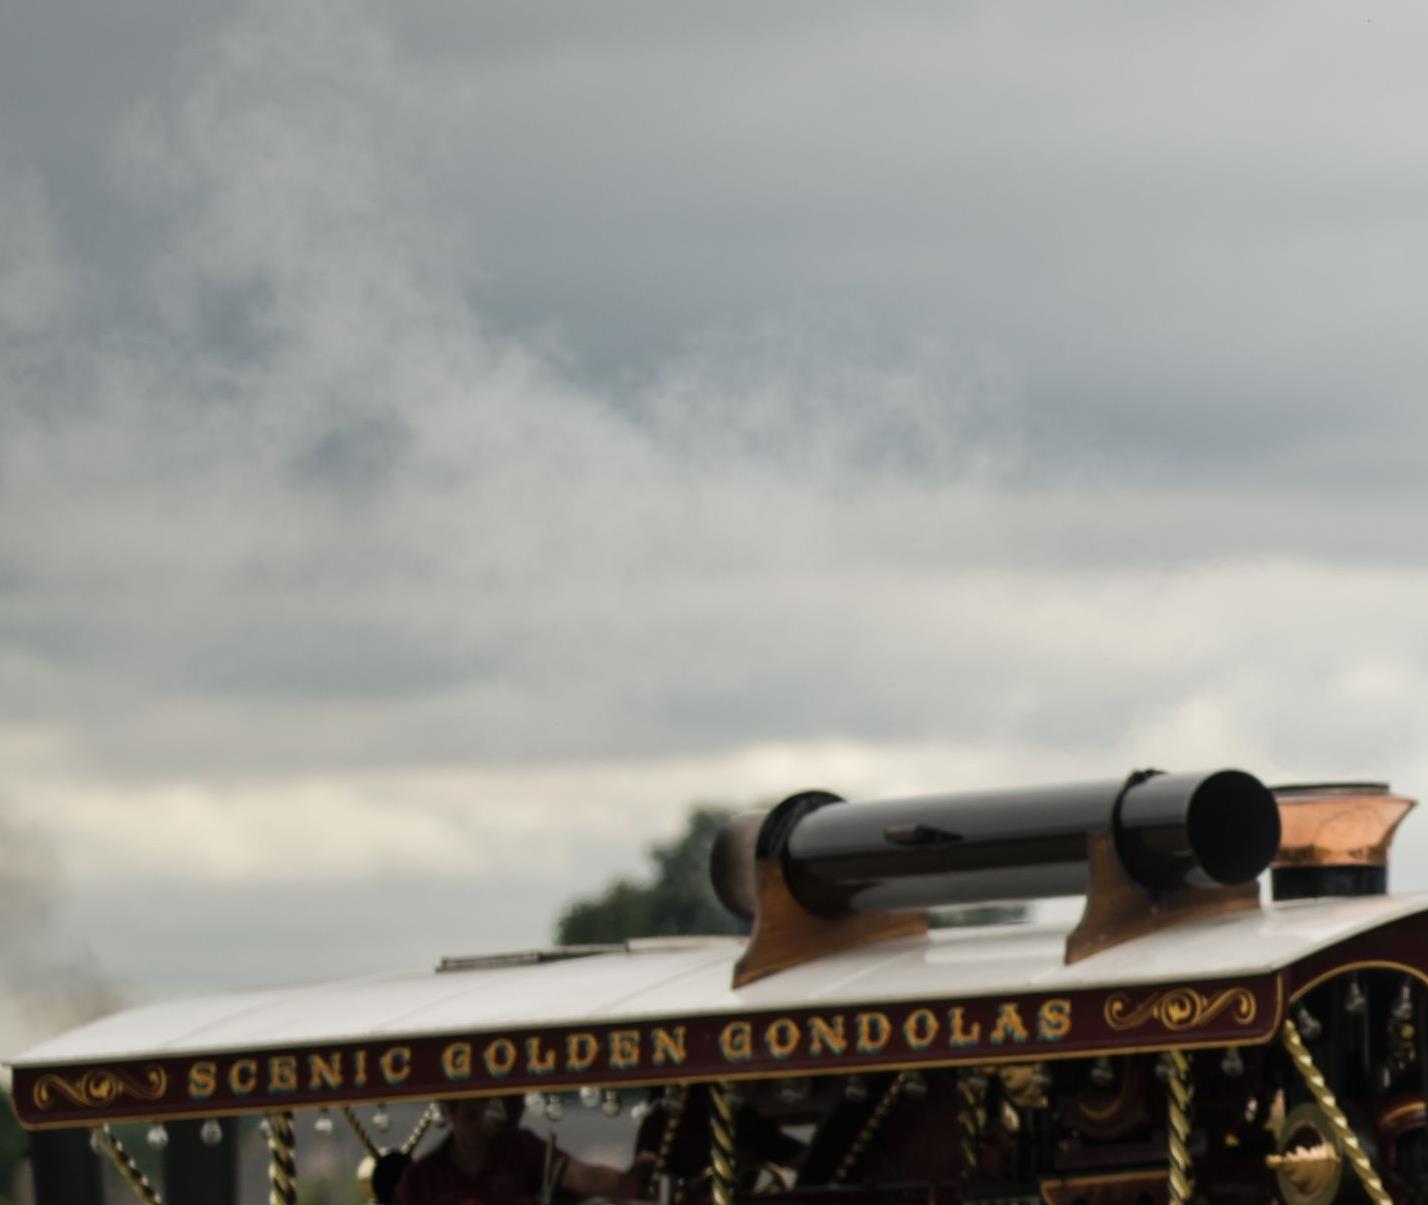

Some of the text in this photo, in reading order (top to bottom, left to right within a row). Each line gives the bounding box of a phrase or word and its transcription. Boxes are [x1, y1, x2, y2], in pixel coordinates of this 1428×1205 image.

[187, 998, 1074, 1099] SCENIC GOLDEN GONDOLAS
